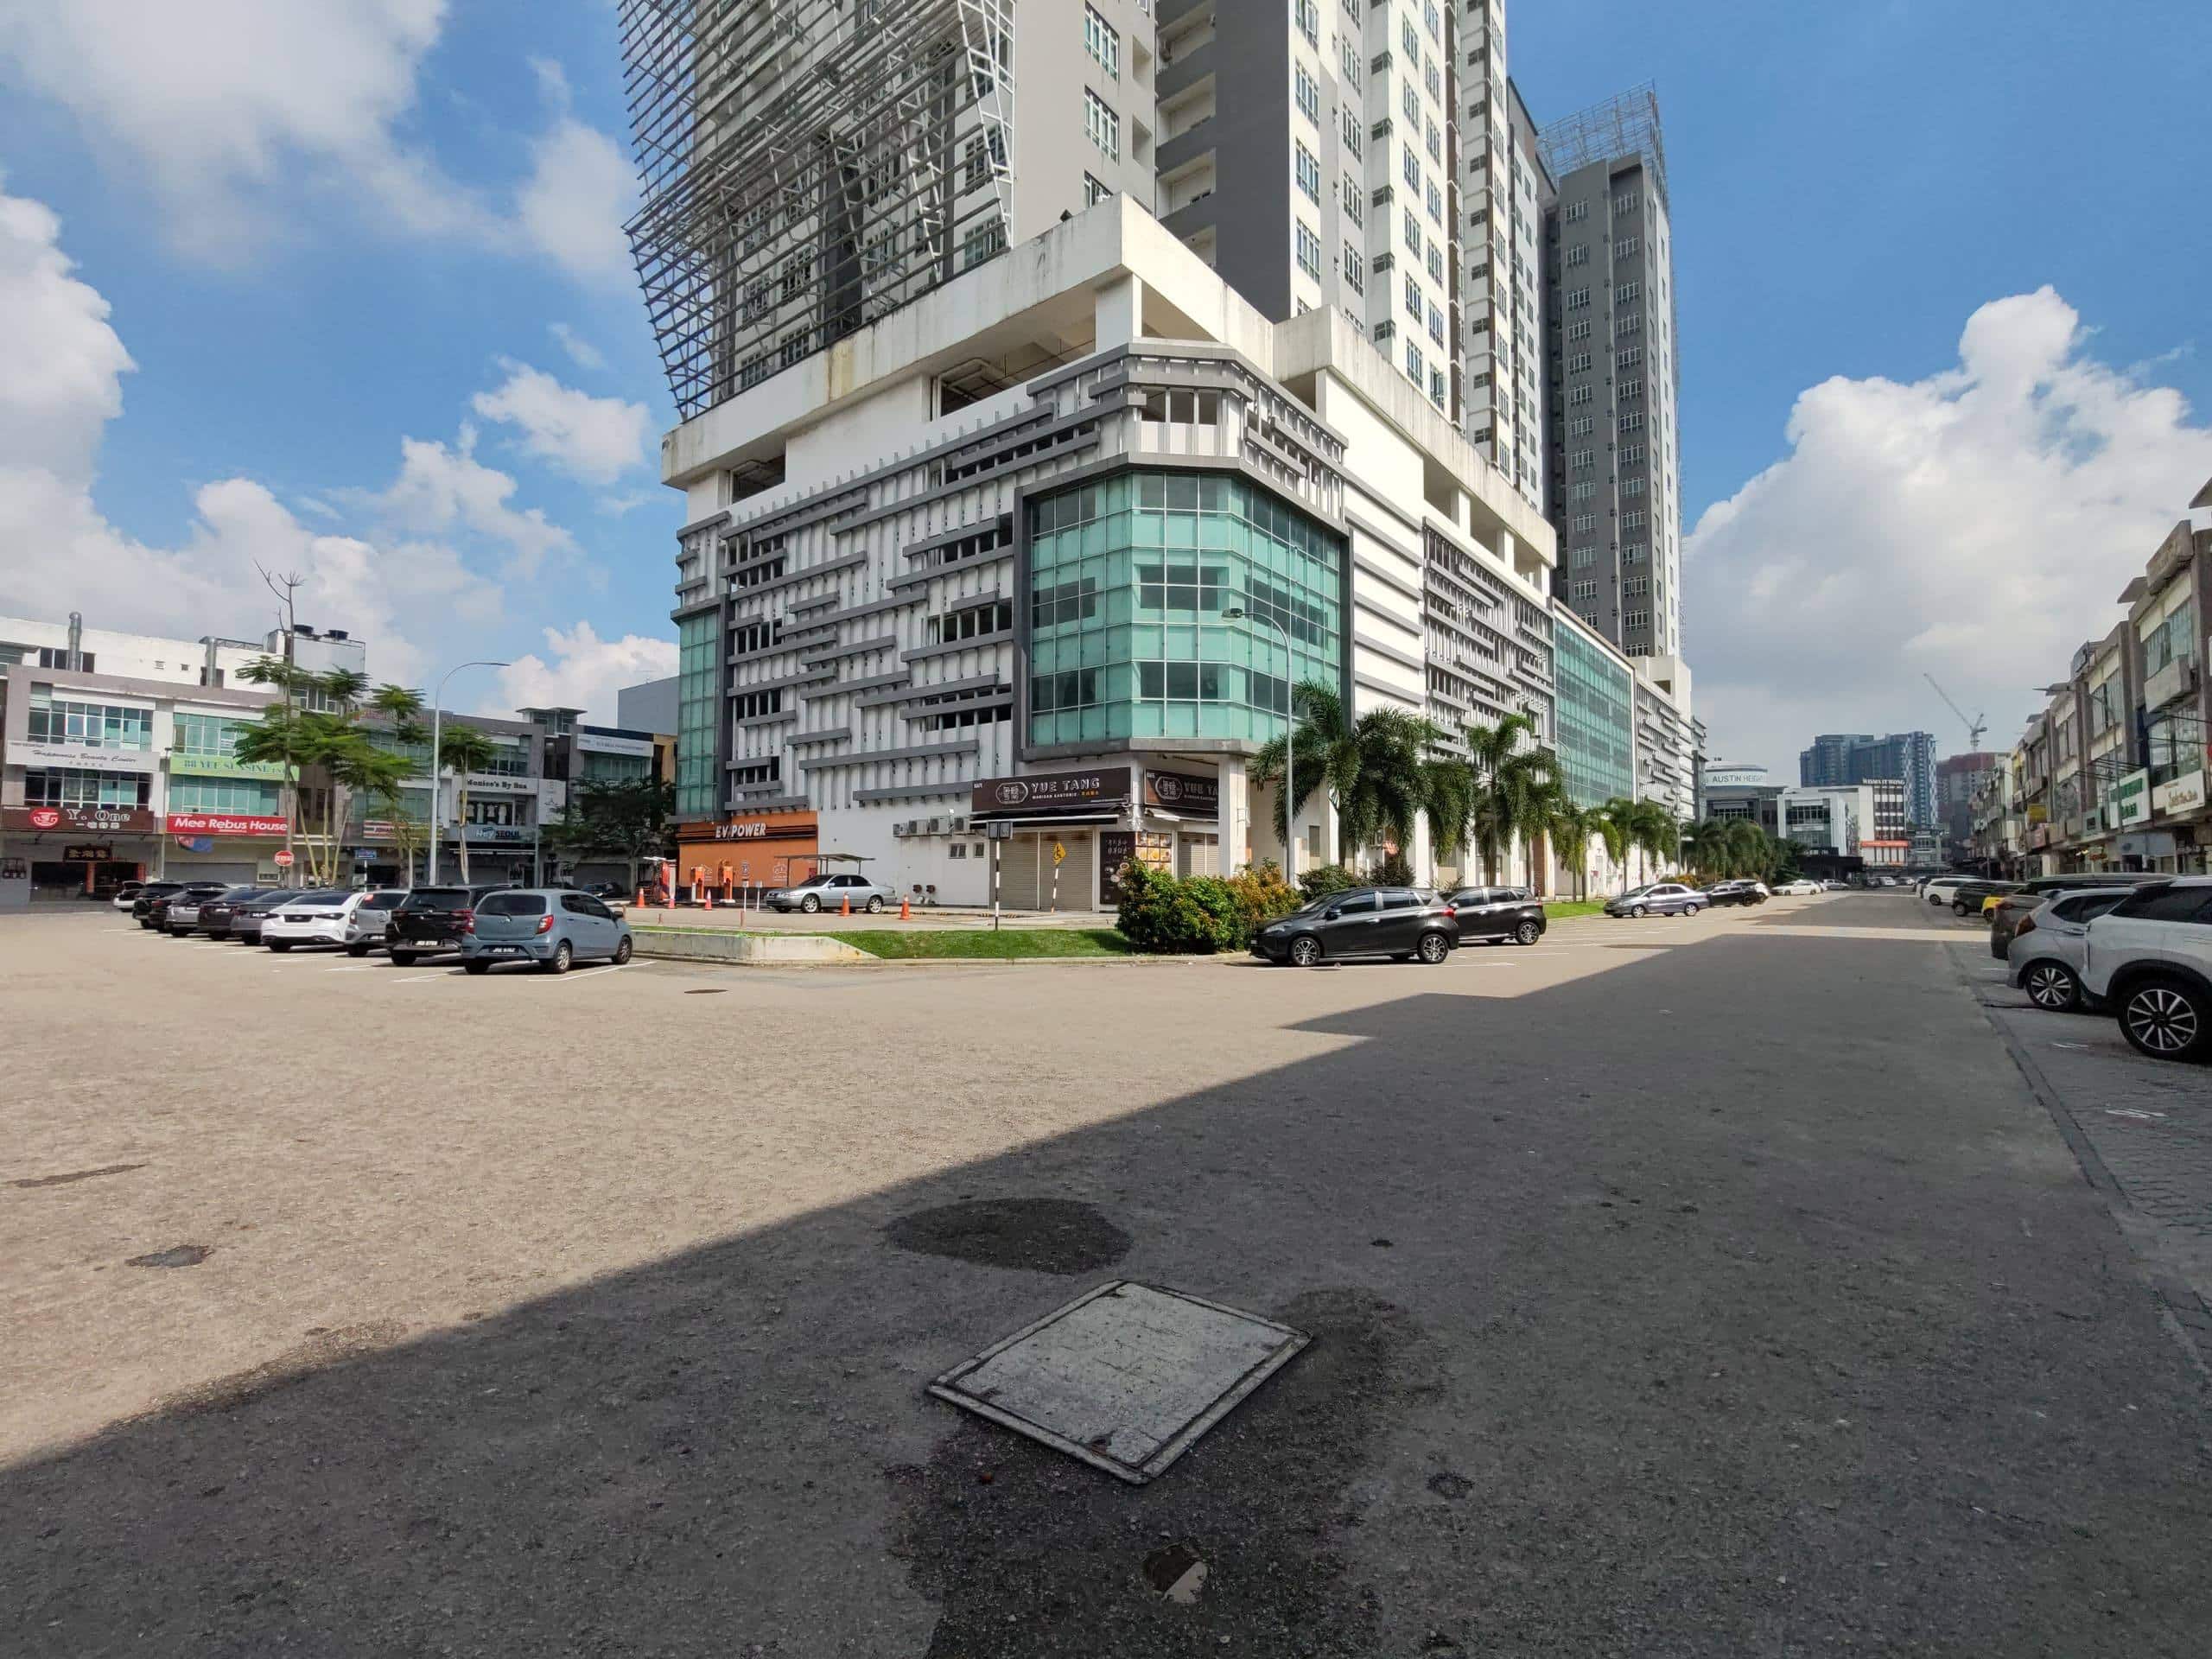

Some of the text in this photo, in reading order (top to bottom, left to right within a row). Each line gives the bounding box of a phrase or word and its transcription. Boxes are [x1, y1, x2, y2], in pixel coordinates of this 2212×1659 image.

[1031, 778, 1100, 793] YUE TANG
[175, 817, 288, 831] Mee Rebus House
[715, 823, 766, 838] EV POWER
